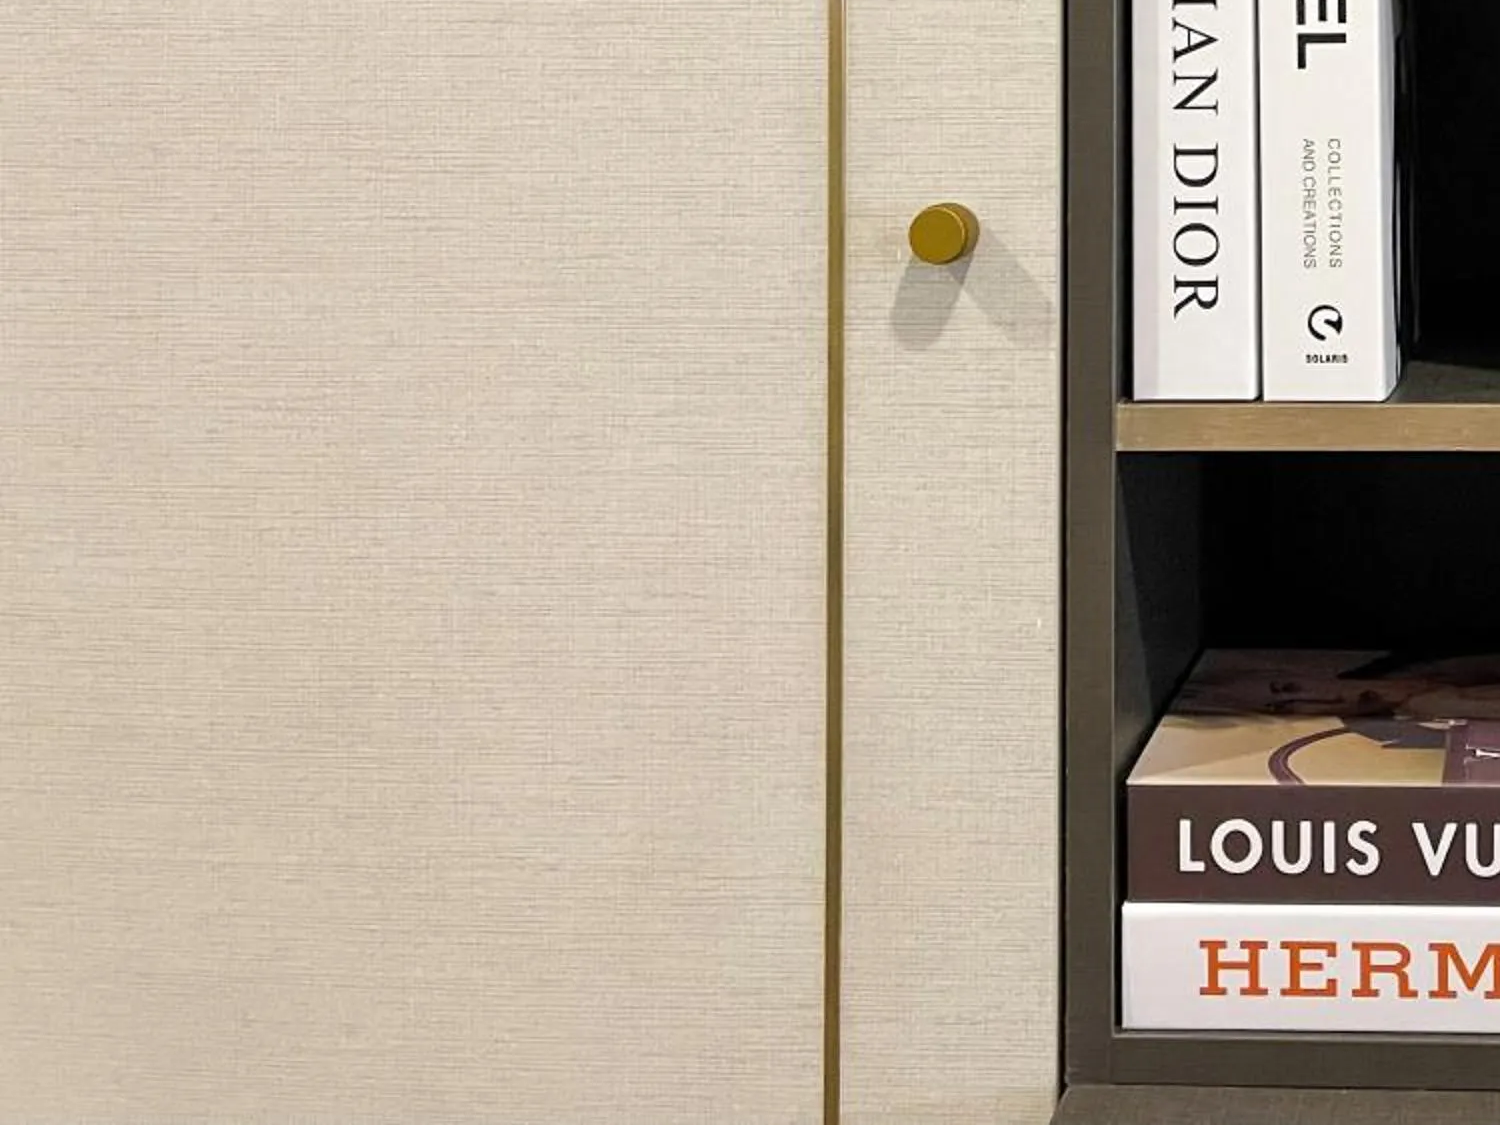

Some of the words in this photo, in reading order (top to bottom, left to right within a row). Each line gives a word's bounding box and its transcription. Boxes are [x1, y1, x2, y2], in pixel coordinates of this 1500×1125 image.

[1302, 138, 1317, 172] AND
[1172, 143, 1220, 318] DIOR
[1302, 176, 1317, 269] CREATIONS
[1327, 138, 1343, 268] COLLECTIONS
[1179, 818, 1380, 876] LOUIS
